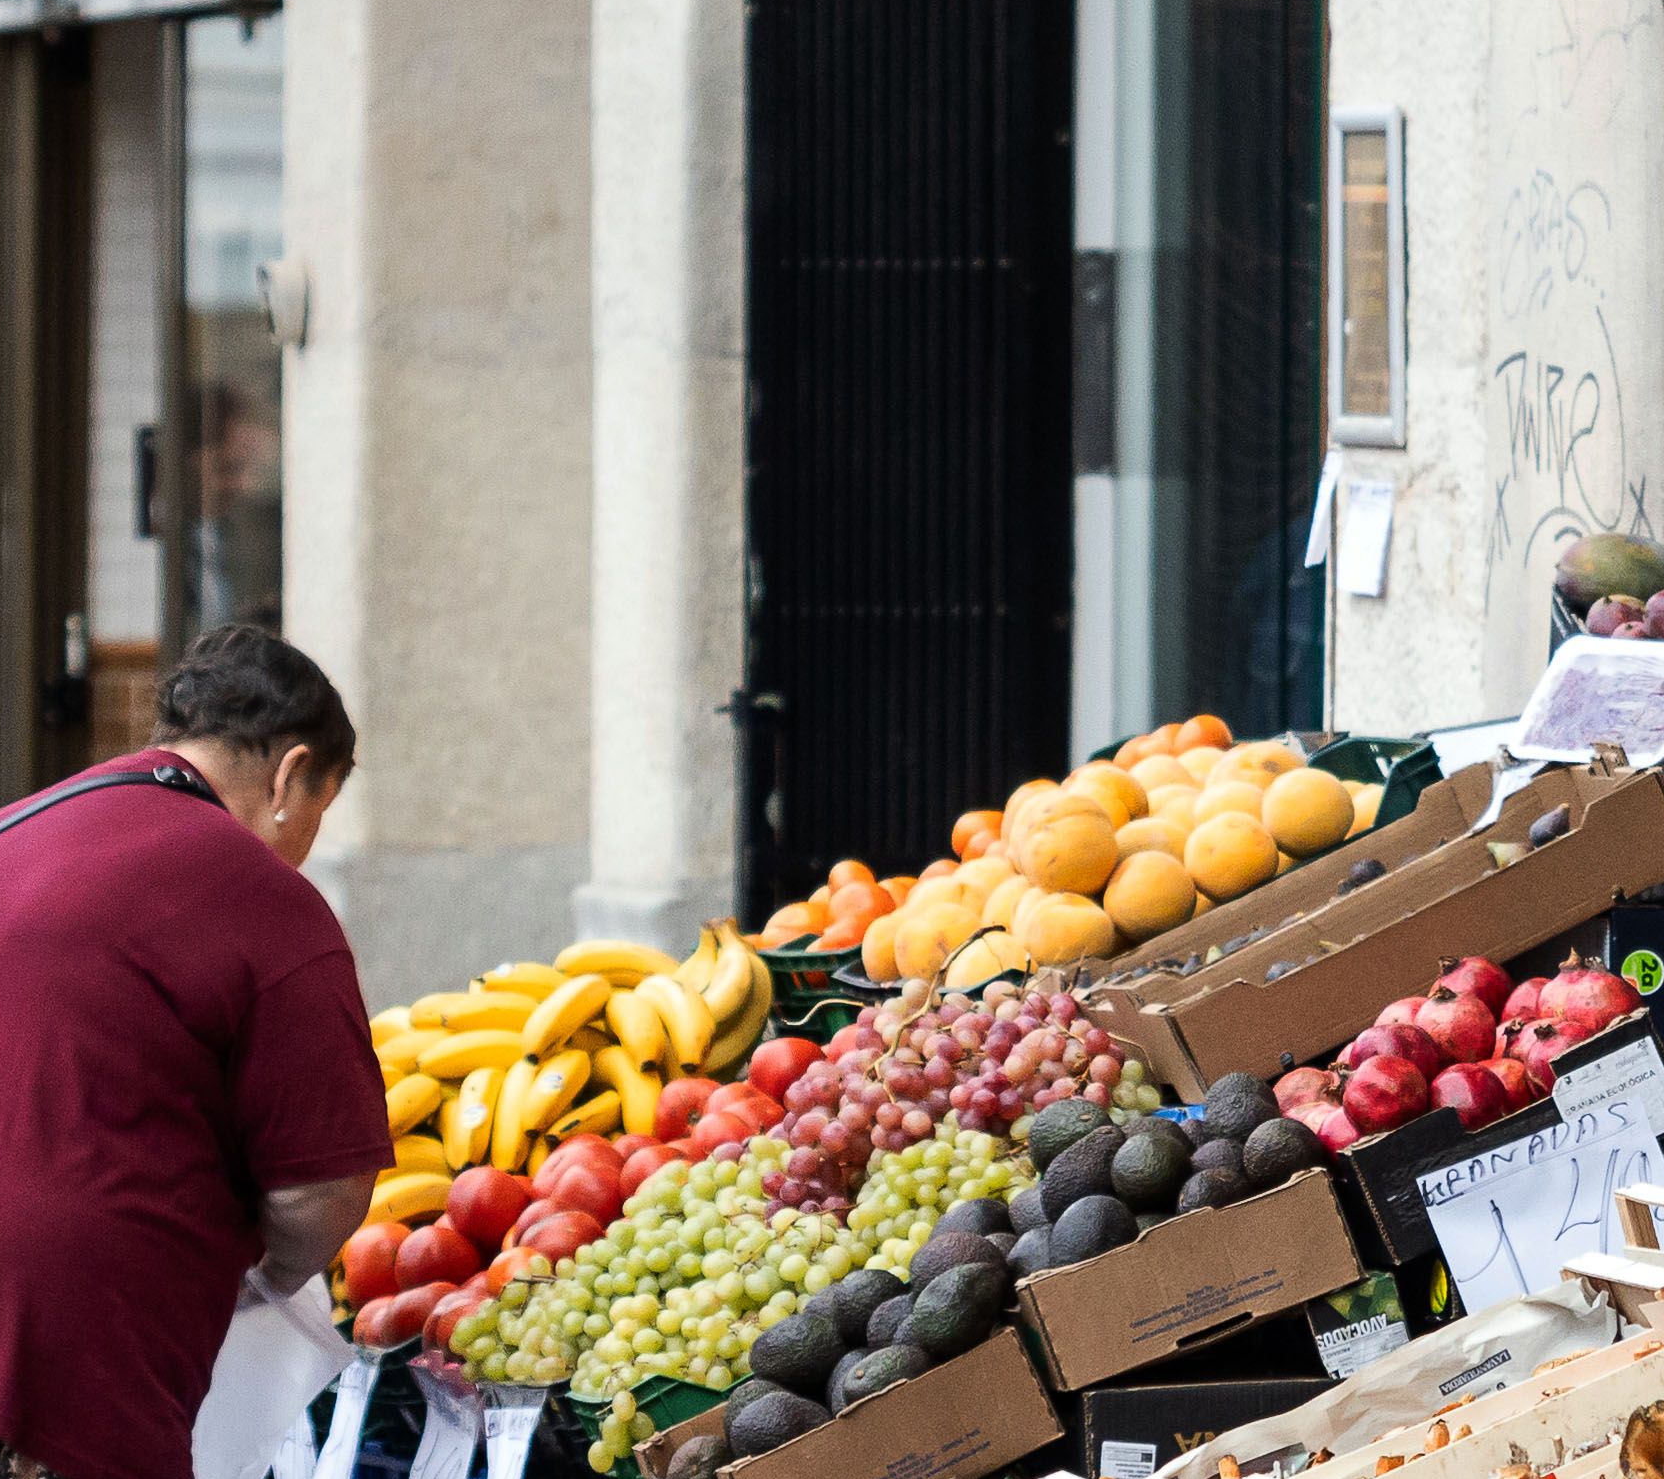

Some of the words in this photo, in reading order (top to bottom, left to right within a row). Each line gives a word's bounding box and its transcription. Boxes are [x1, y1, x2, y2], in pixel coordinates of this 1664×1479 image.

[1564, 1091, 1607, 1117] GRANADA
[1606, 1067, 1657, 1098] ECOLÓGICA
[1316, 1313, 1388, 1349] AVOCADOS
